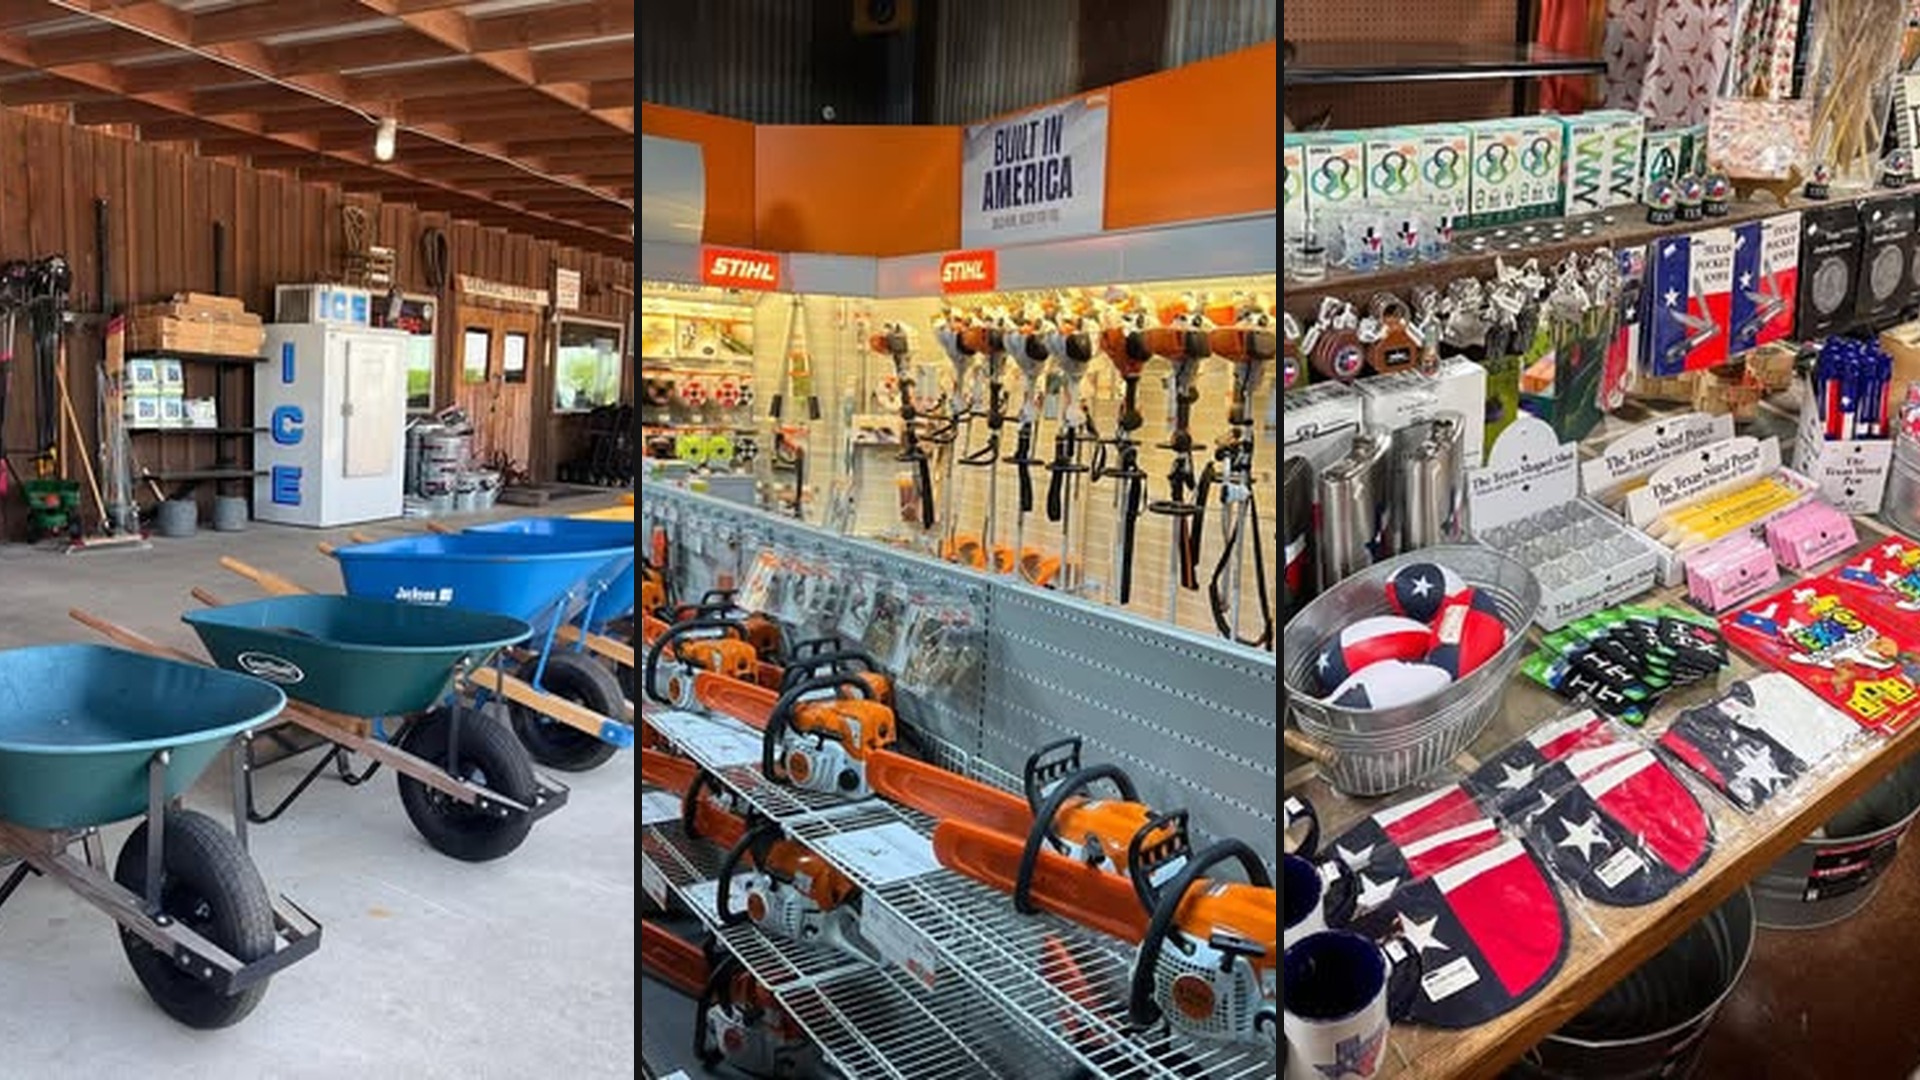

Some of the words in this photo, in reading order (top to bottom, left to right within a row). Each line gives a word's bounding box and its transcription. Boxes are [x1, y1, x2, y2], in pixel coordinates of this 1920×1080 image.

[994, 120, 1039, 166] BUILT
[1042, 114, 1063, 156] IN
[982, 155, 1072, 211] AMERICA
[711, 257, 775, 281] STIHL
[942, 260, 987, 283] STIHL
[319, 291, 366, 321] ICE
[272, 342, 304, 505] ICE
[1653, 483, 1673, 498] The
